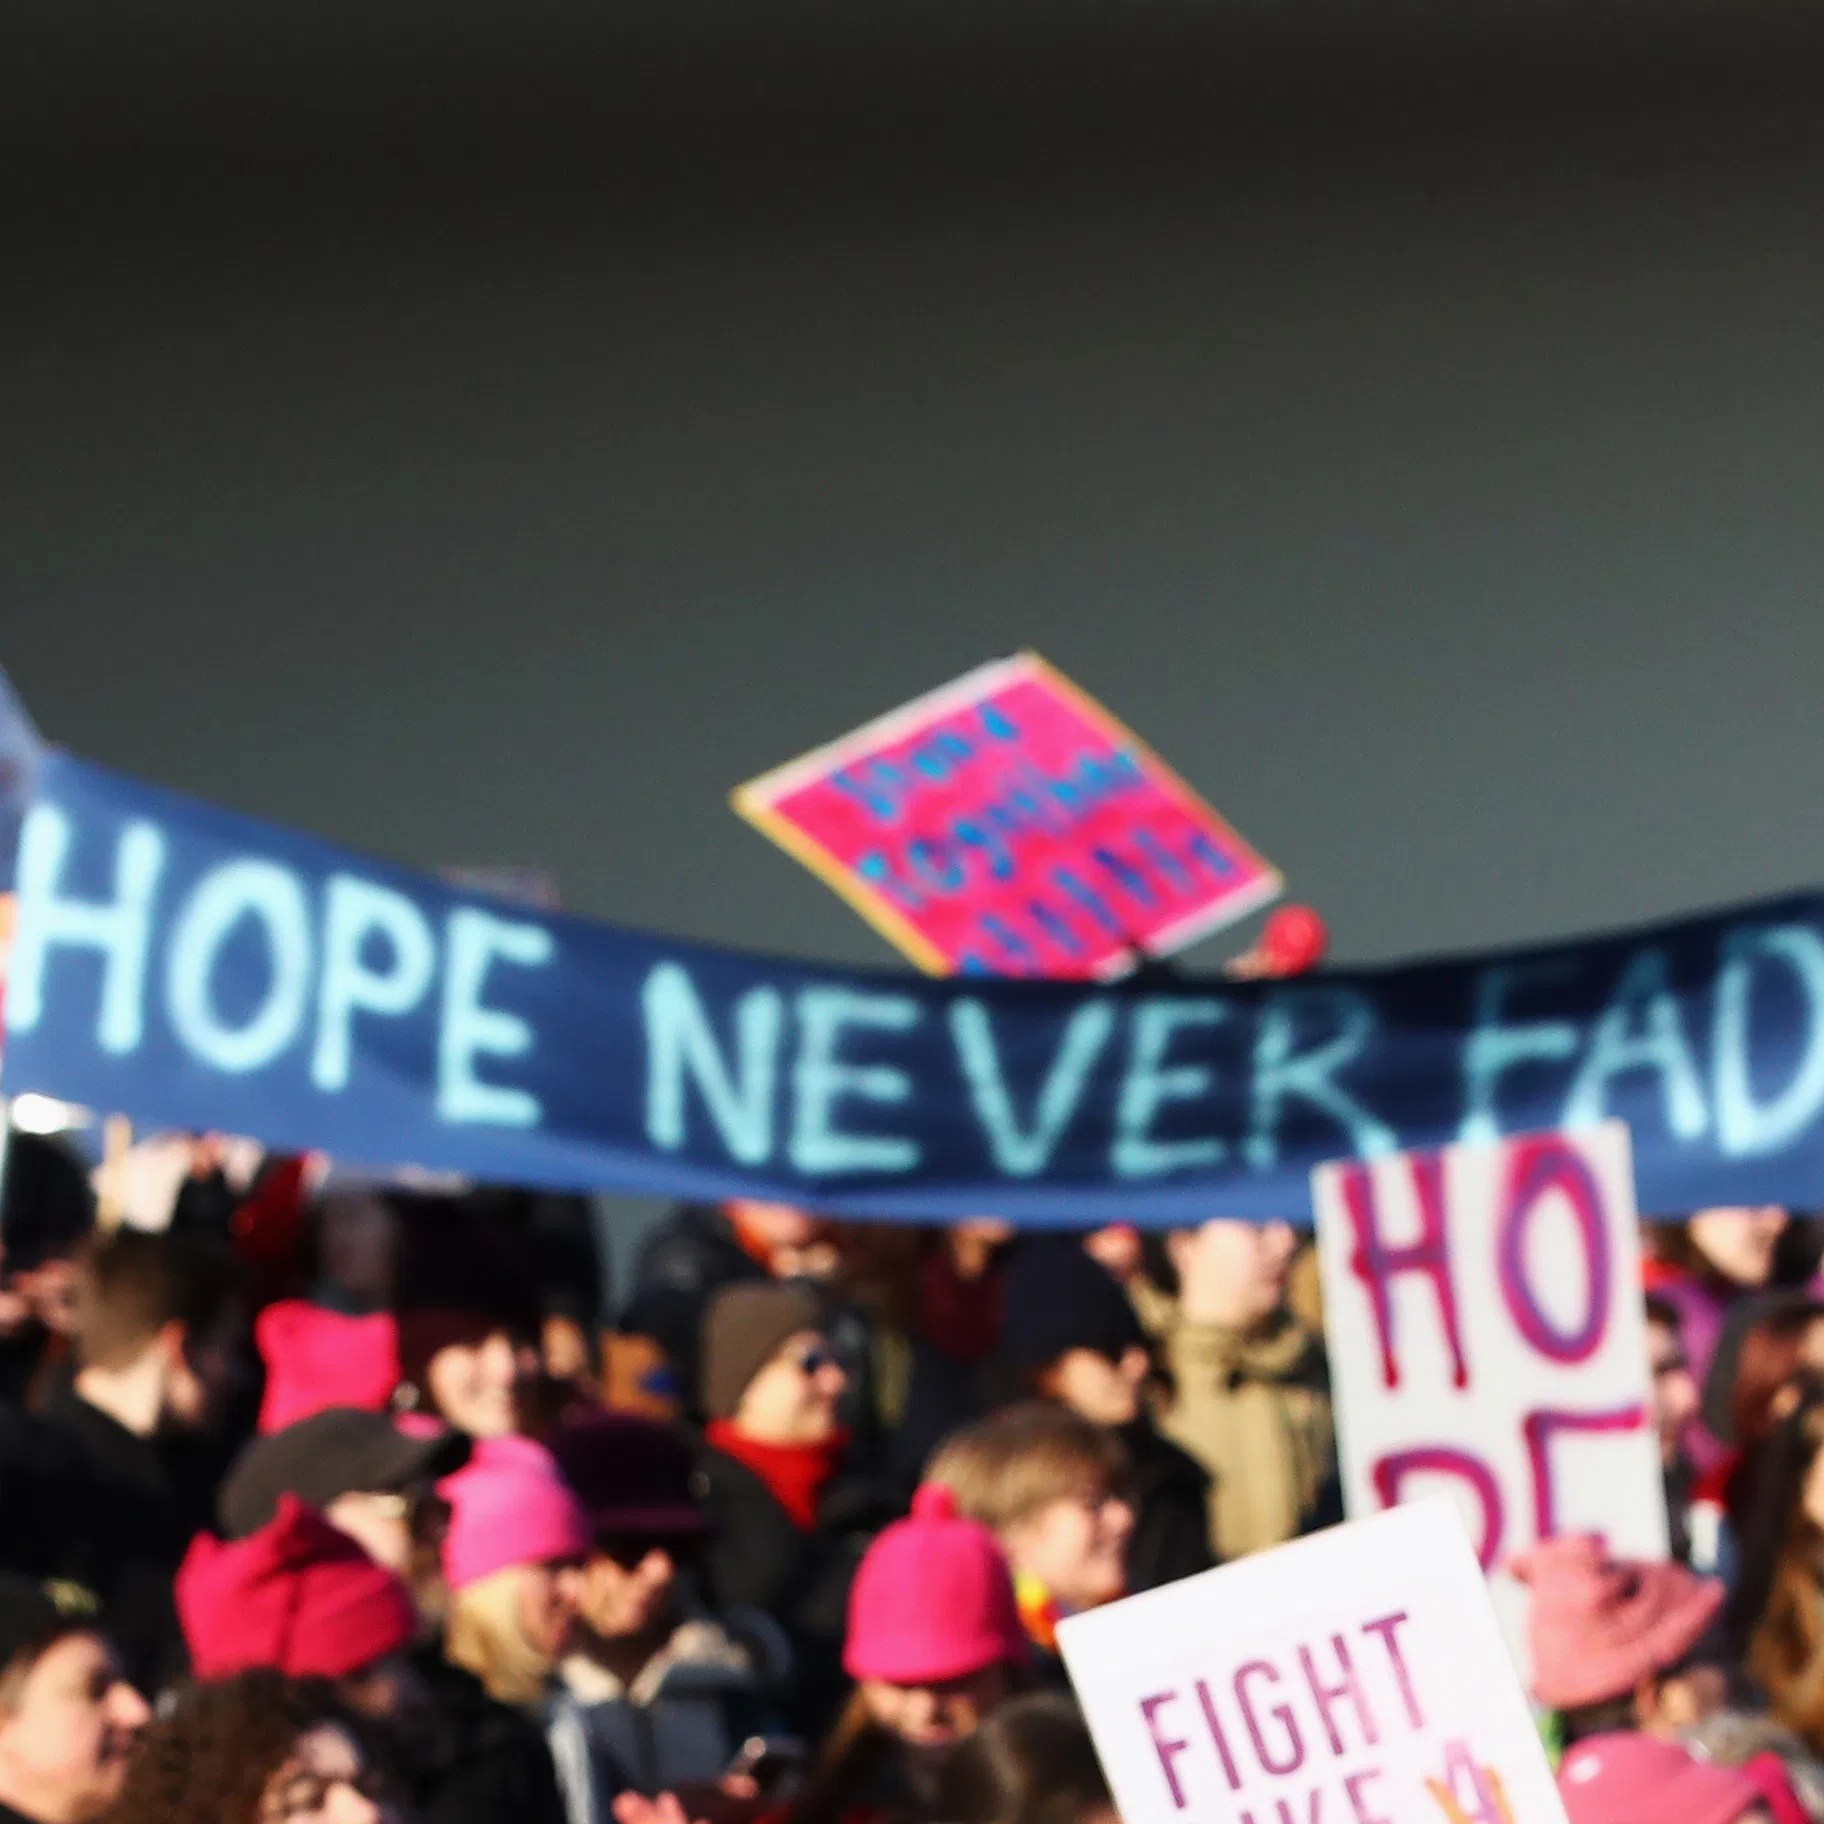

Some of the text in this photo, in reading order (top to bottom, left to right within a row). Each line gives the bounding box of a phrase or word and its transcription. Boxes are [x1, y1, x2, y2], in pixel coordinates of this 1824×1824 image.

[6, 800, 557, 1129] HOPE
[640, 956, 1398, 1177] NEVER
[1340, 1131, 1612, 1391] HO
[1139, 1609, 1429, 1810] FIGHT
